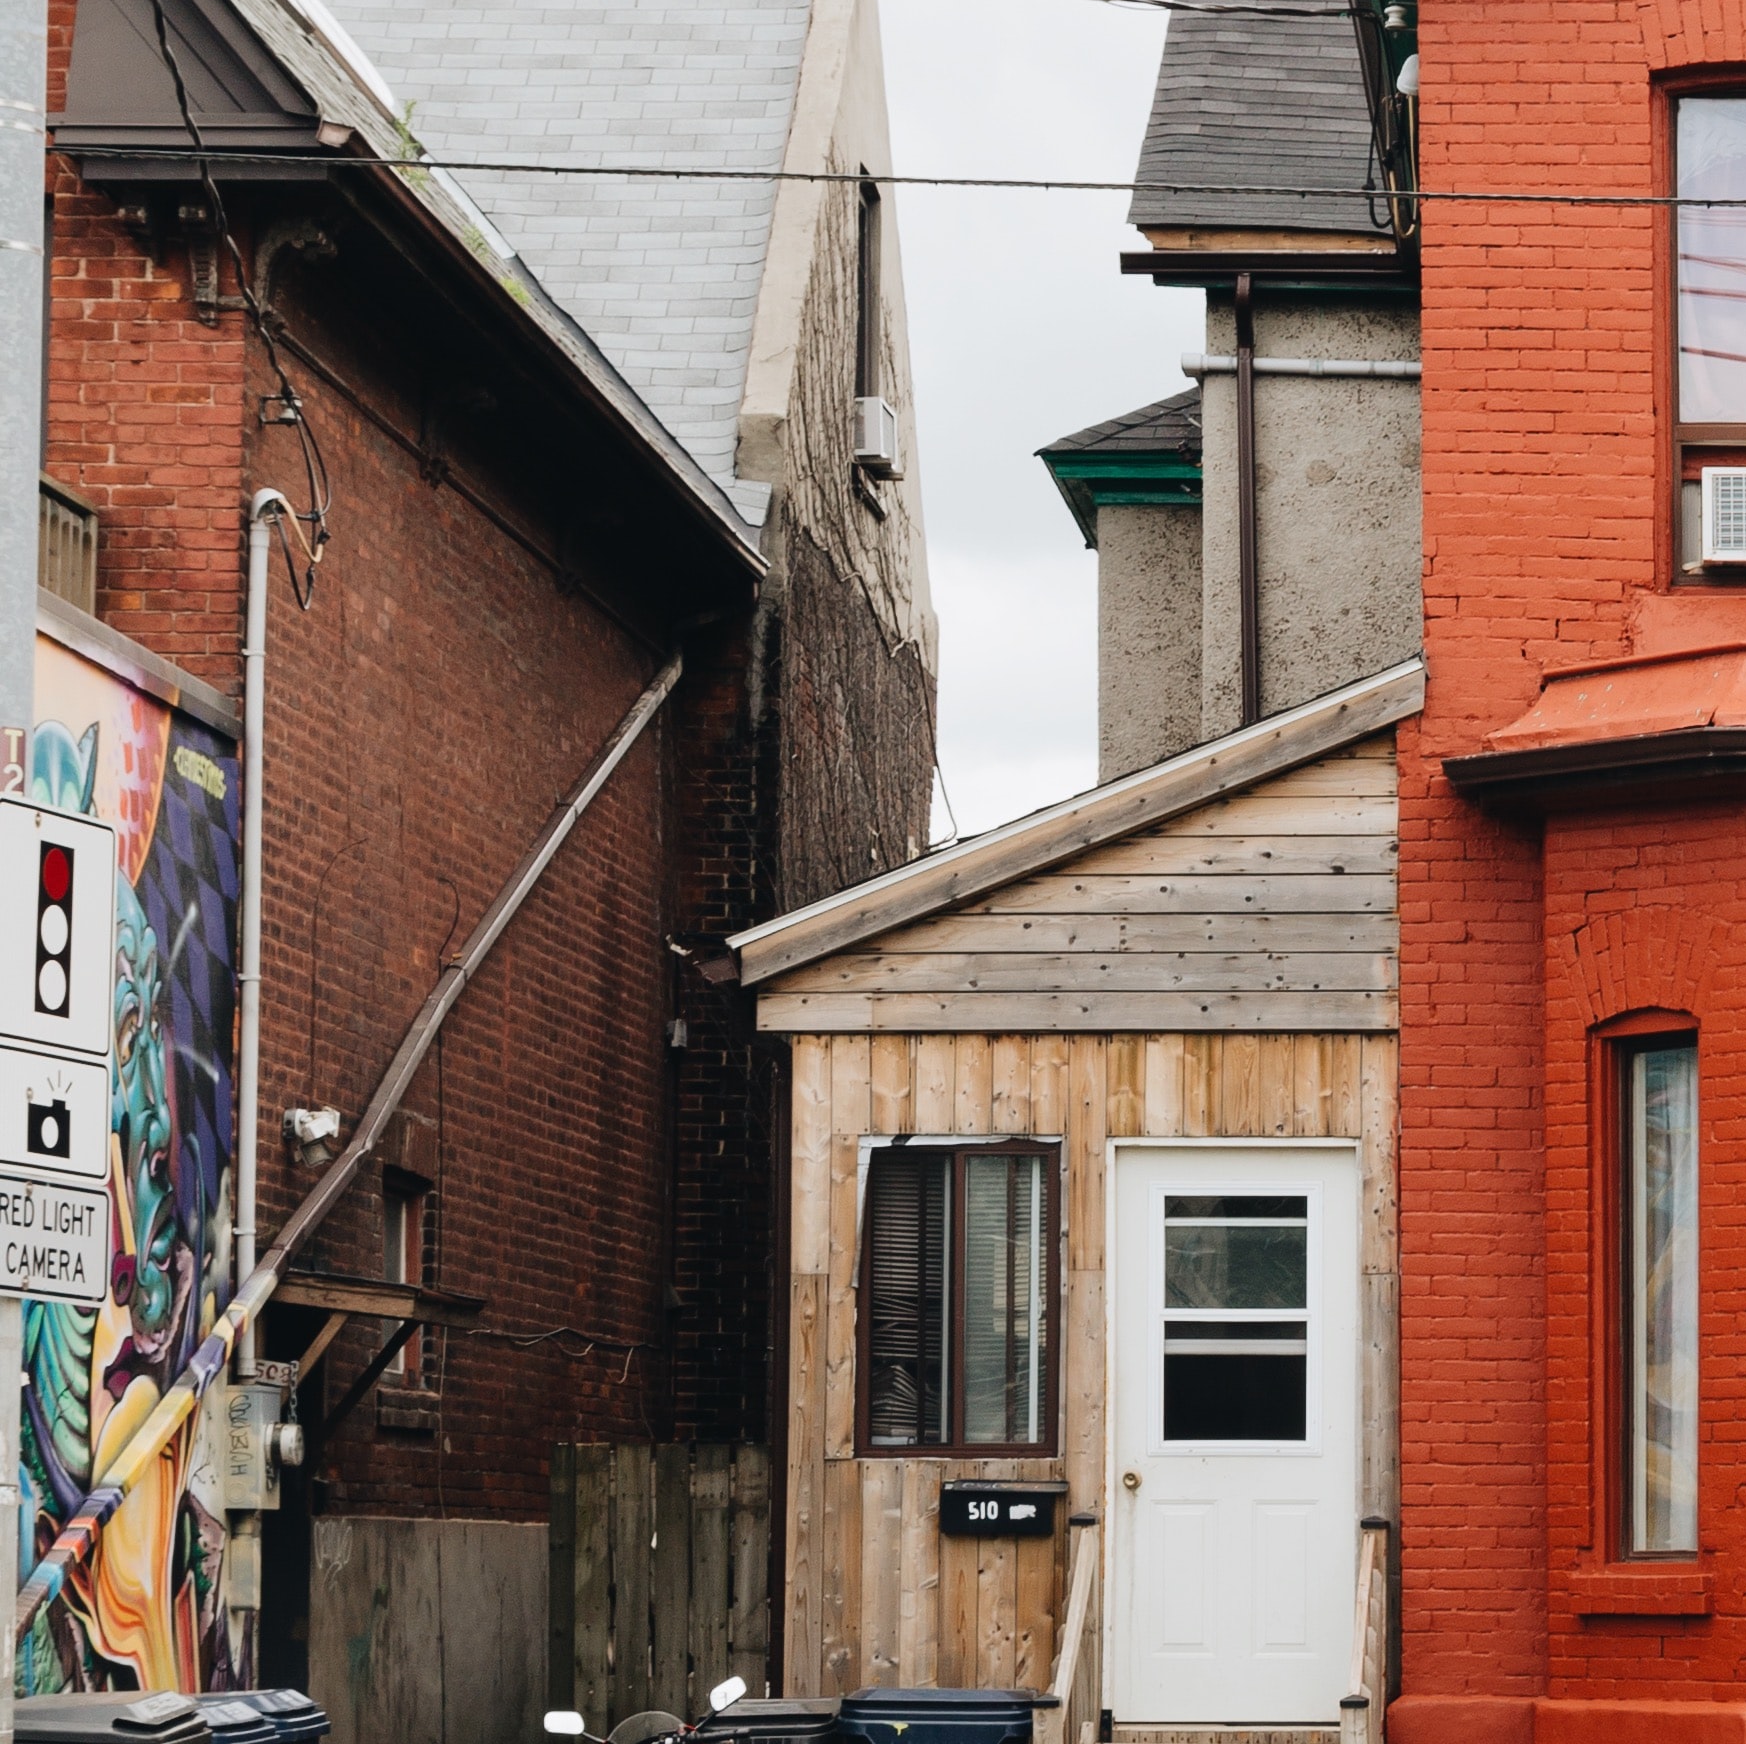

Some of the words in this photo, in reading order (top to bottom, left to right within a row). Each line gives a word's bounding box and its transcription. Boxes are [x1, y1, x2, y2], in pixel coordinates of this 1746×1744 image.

[0, 1192, 35, 1227] RED
[42, 1199, 95, 1237] LIGHT
[6, 1242, 85, 1283] CAMERA
[968, 1501, 999, 1520] 510
